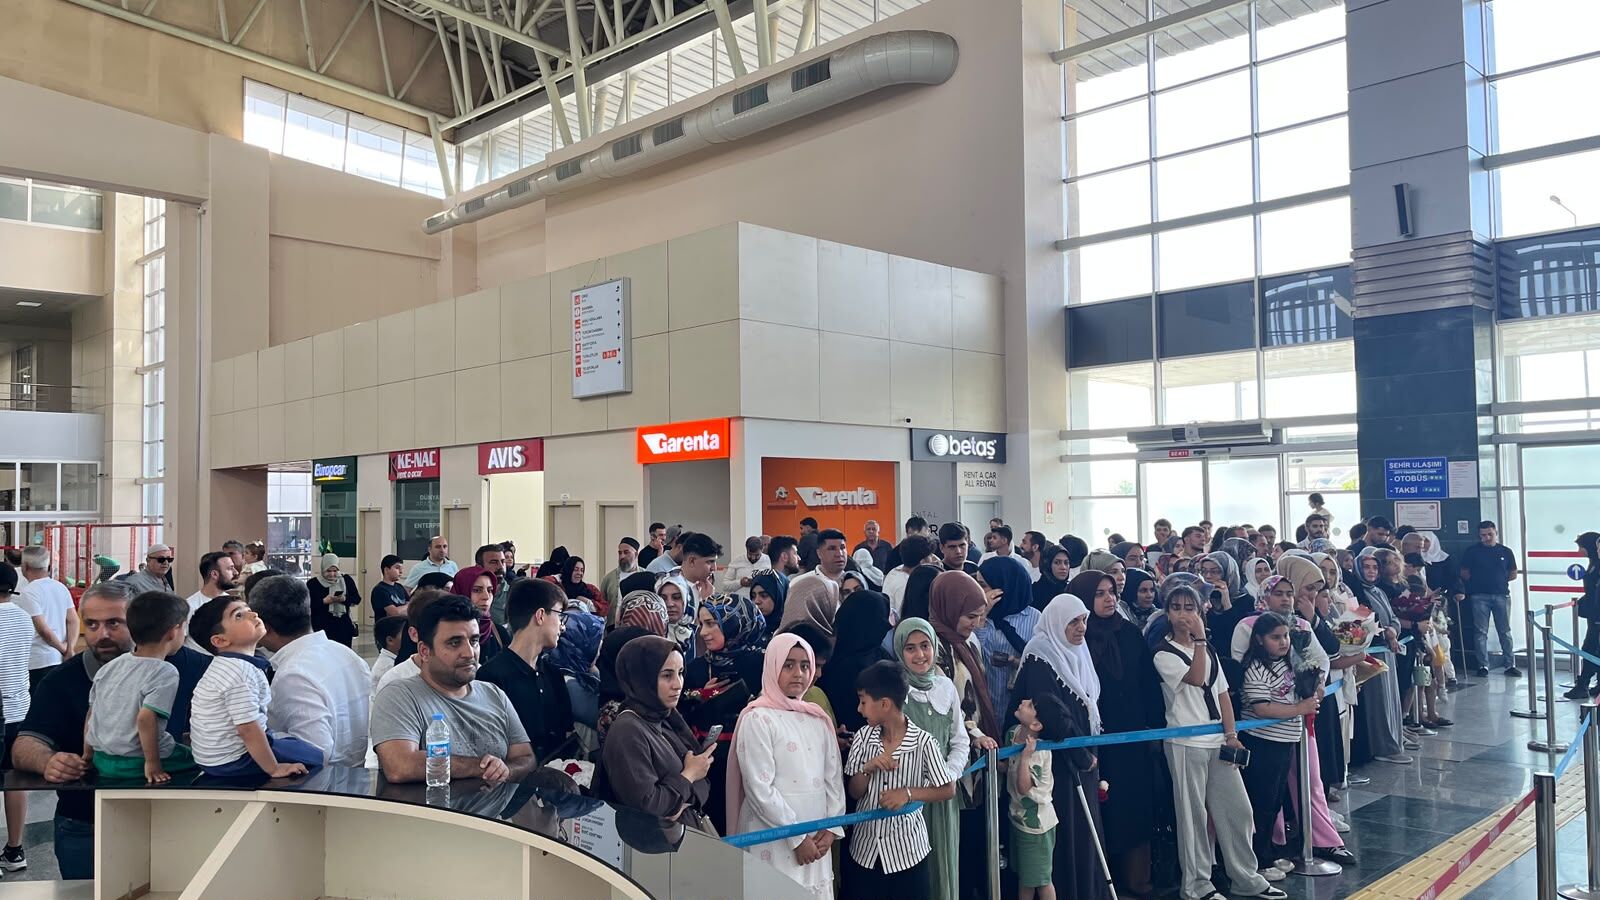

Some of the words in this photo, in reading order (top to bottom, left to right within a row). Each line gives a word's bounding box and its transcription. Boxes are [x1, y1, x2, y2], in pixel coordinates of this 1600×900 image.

[642, 430, 720, 455] Garenta
[397, 450, 437, 469] KE-NAC
[487, 445, 523, 469] AVIS
[1389, 461, 1411, 469] ŞEHİR
[1412, 461, 1442, 469] ULAŞIMI
[314, 463, 347, 480] Europcar
[985, 471, 997, 479] CAR
[1394, 474, 1428, 482] OTOBÜS
[795, 486, 877, 507] Garenta
[1394, 485, 1418, 493] TAKSİ
